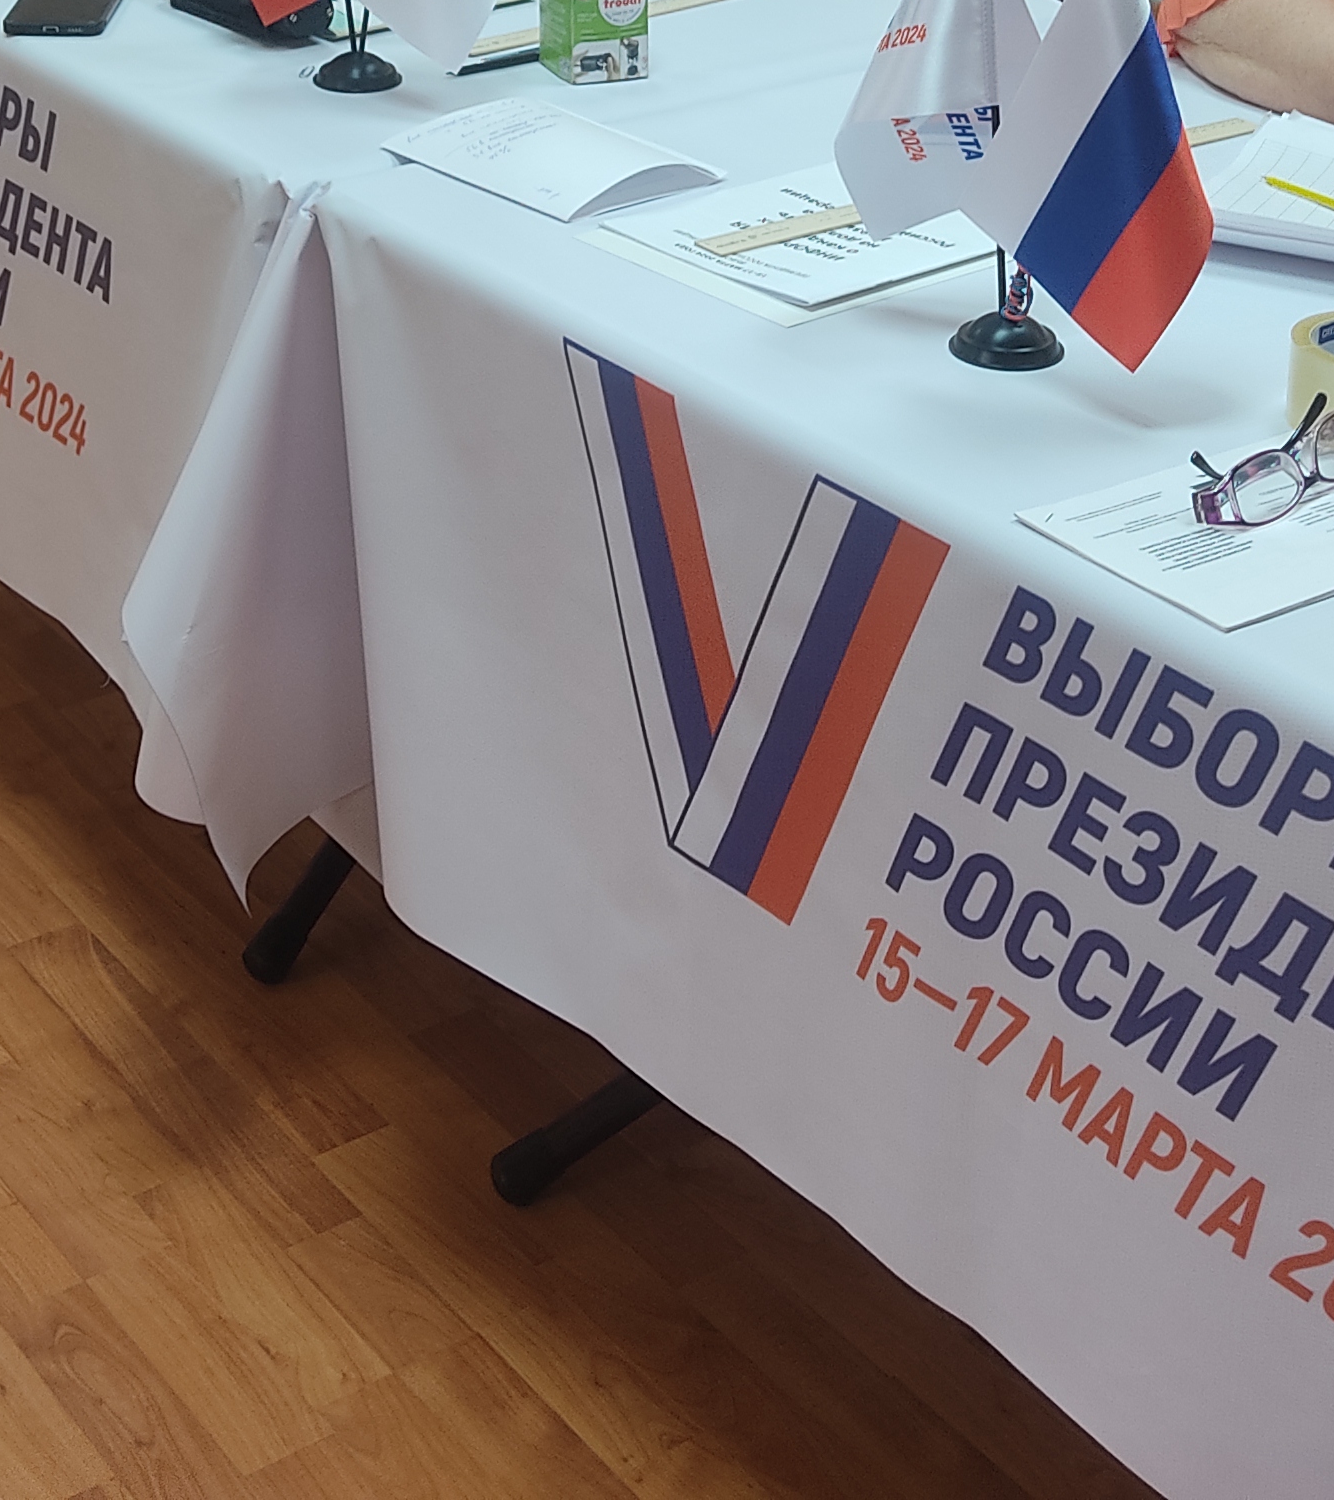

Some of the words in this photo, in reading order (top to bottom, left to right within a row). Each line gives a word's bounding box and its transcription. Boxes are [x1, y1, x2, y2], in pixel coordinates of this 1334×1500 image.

[891, 23, 928, 50] 2024
[895, 128, 928, 164] 2024
[19, 371, 90, 456] 2024
[885, 813, 1277, 1123] РОССИИ
[1026, 1036, 1267, 1260] МАРТА
